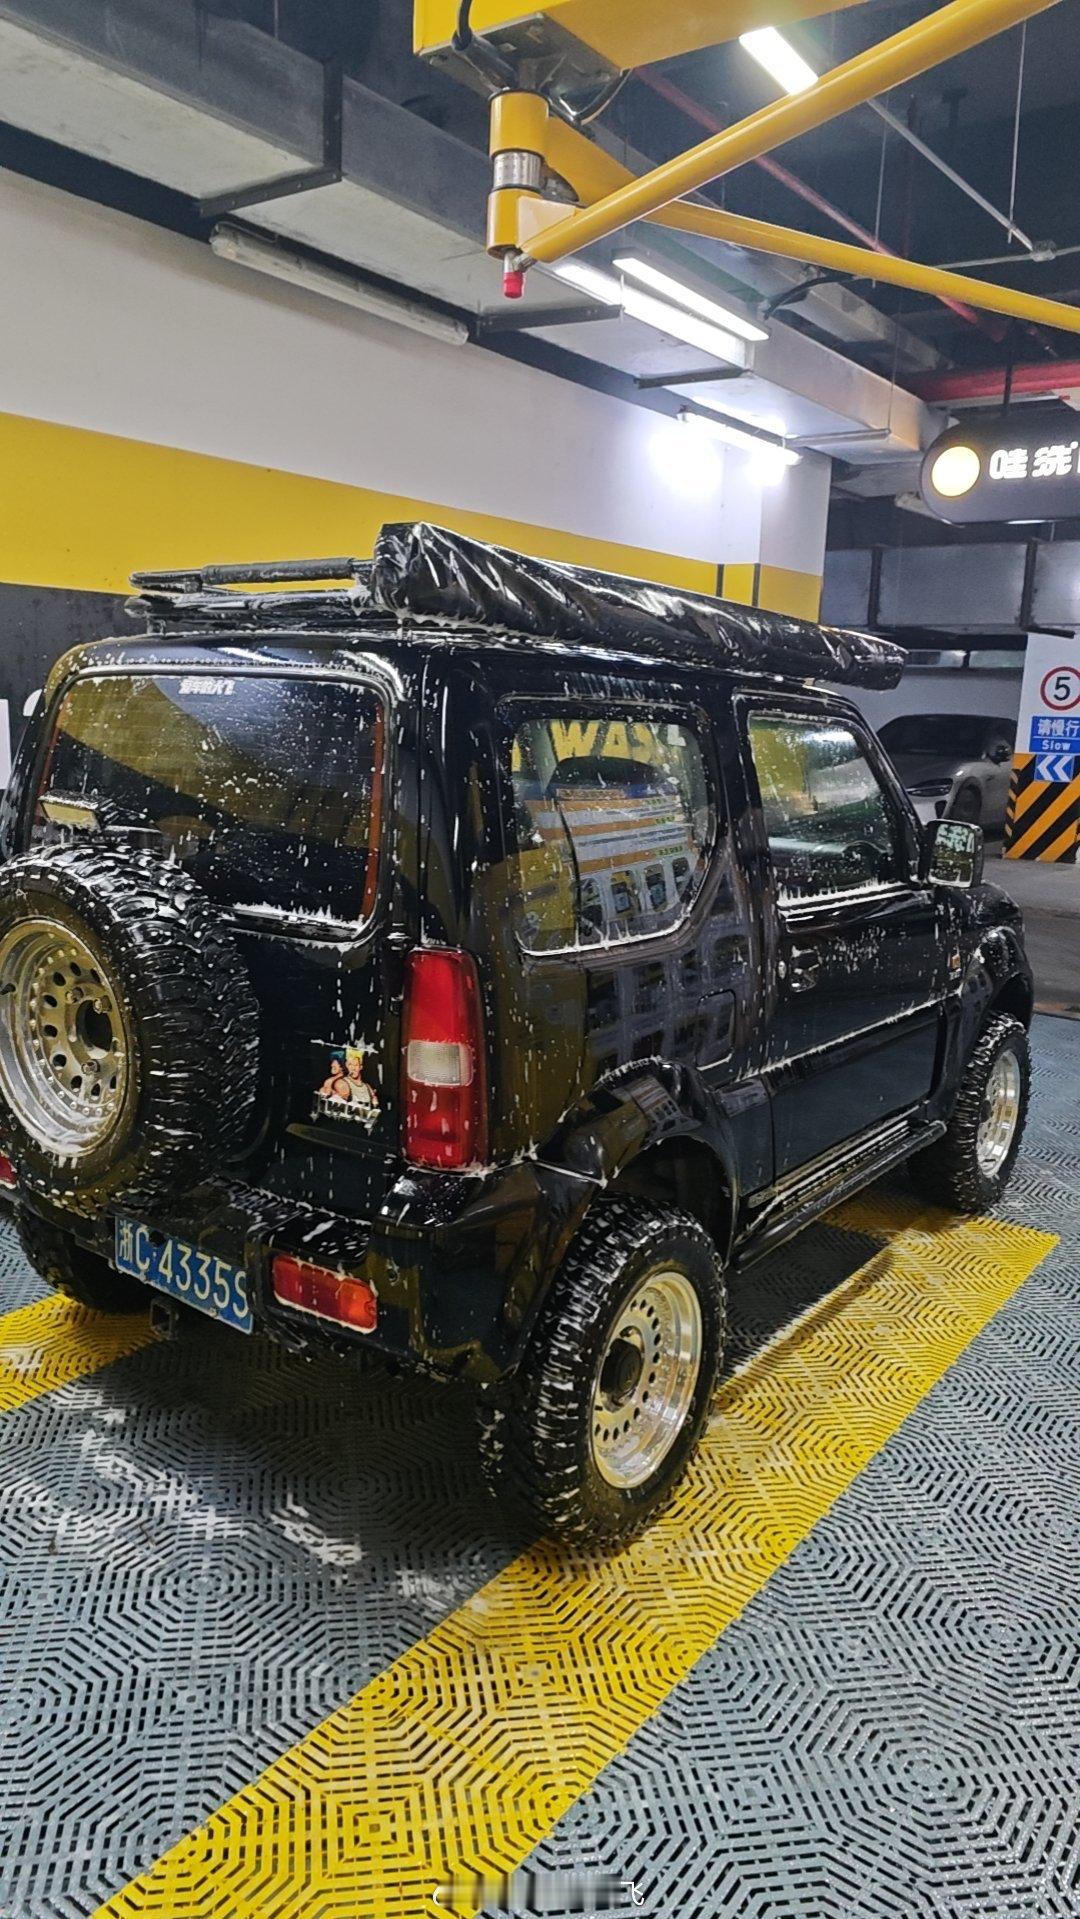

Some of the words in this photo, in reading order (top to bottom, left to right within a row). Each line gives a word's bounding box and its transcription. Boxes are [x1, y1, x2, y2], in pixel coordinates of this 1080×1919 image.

[989, 441, 1080, 480] 哇洗
[1053, 676, 1071, 701] 5
[1037, 718, 1080, 737] 请慢行
[1042, 739, 1071, 751] Slow
